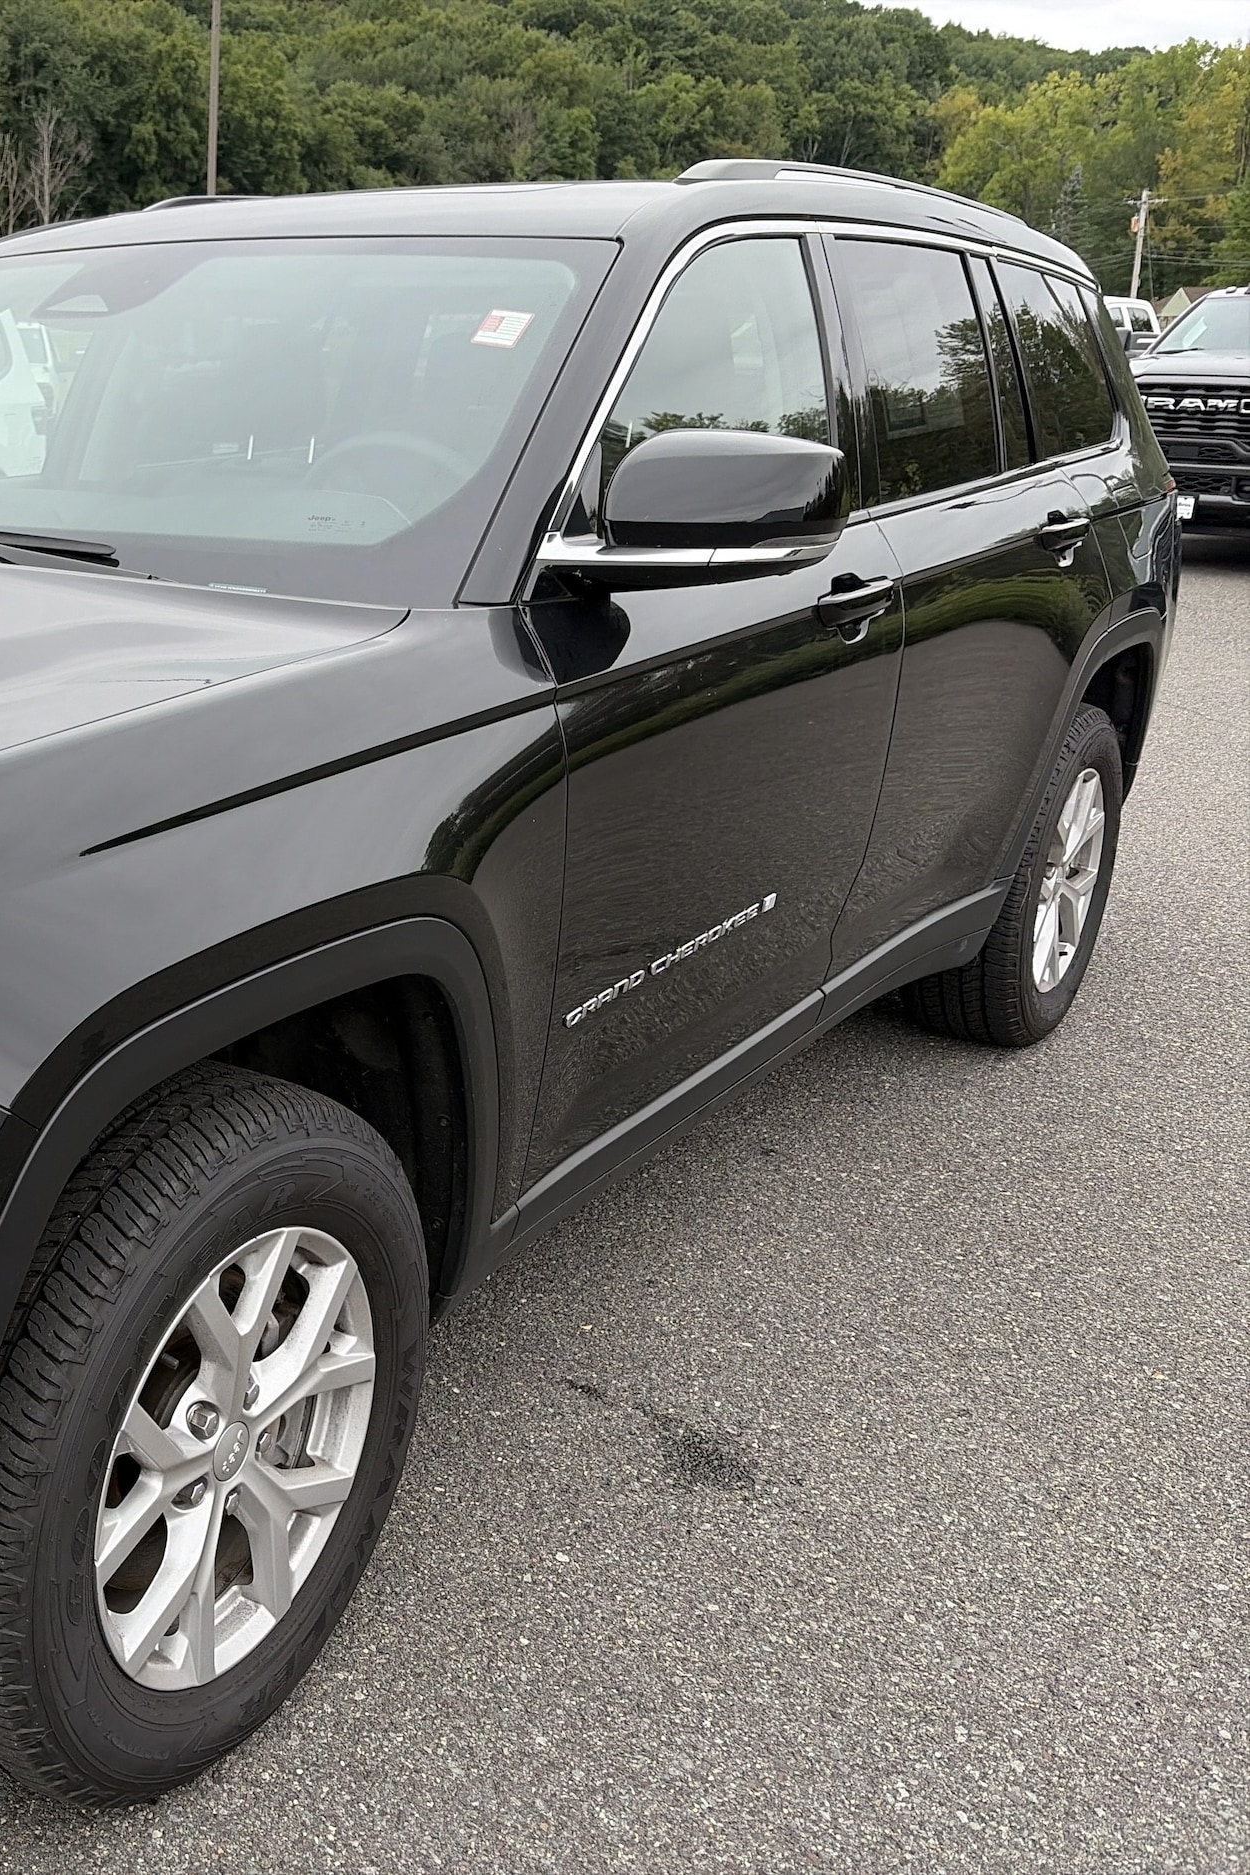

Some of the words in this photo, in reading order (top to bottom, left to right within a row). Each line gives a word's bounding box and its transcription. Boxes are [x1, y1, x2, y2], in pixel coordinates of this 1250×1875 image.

[1146, 396, 1239, 411] RAM
[565, 969, 646, 1028] GRAND
[650, 902, 761, 976] CHEROKEE
